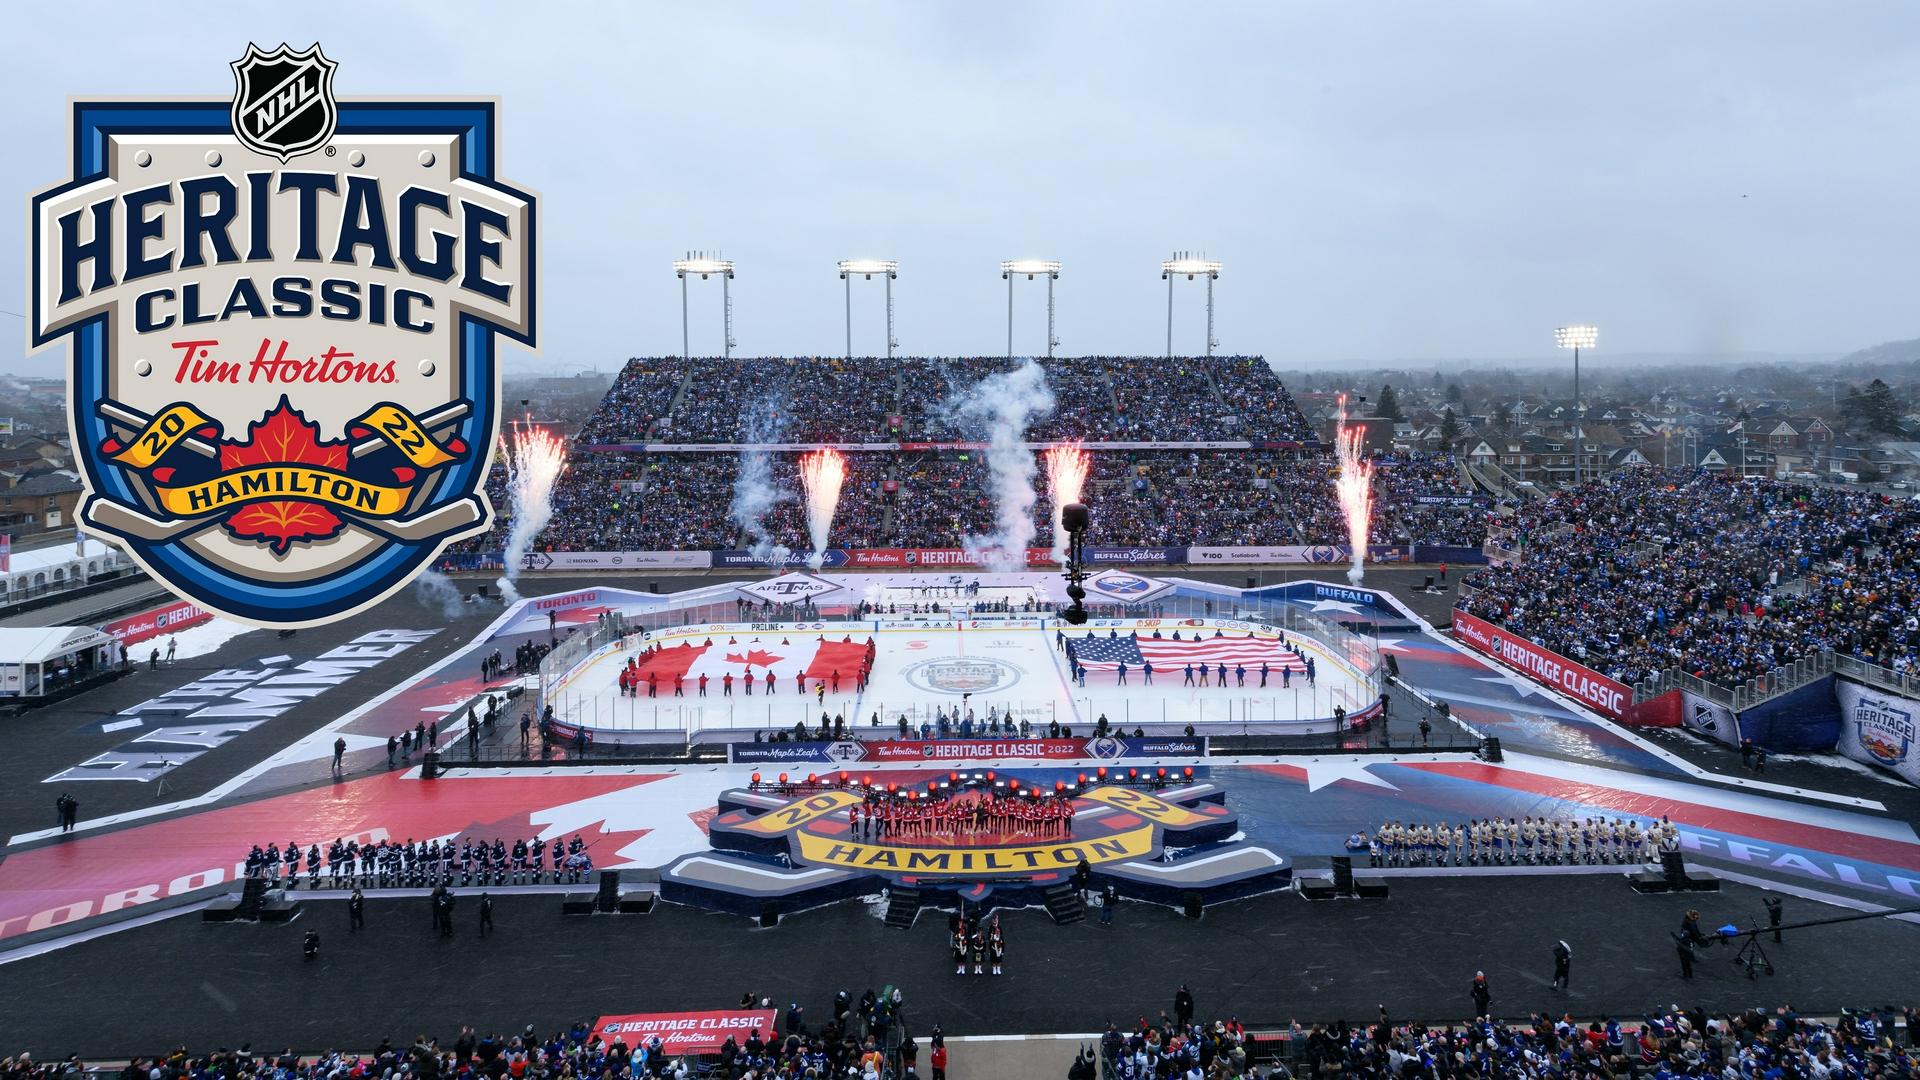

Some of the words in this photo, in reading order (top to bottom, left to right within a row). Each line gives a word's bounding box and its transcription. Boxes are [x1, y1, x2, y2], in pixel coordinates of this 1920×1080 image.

[763, 552, 801, 566] Maple
[856, 553, 869, 563] Tim
[868, 552, 899, 562] Hortons
[921, 551, 978, 564] HERITAGE
[1129, 549, 1167, 562] Sabres
[535, 592, 596, 610] TORONTO
[1317, 587, 1373, 603] BUFFALO
[112, 627, 127, 640] Tim
[126, 621, 155, 637] Hortons
[751, 623, 779, 631] PROLINE
[1144, 619, 1161, 627] SKIP
[61, 632, 99, 649] SPORTSNET
[926, 666, 1002, 675] HERITAGE
[1455, 618, 1466, 635] Tim
[1465, 622, 1490, 647] Hortons
[1503, 639, 1561, 684] HERITAGE
[1563, 669, 1624, 715] CLASSIC
[117, 668, 279, 716] THE
[41, 628, 447, 783] HAMMER
[1856, 709, 1912, 738] HERITAGE
[1863, 721, 1901, 739] CLASSIC
[768, 748, 794, 759] Maple
[795, 747, 819, 757] Leafs
[878, 746, 894, 756] Tim
[893, 746, 920, 756] Hortons
[936, 744, 993, 757] HERITAGE
[995, 743, 1045, 757] CLASSIC
[1047, 745, 1074, 754] 2022
[1168, 742, 1196, 753] Sabres
[777, 796, 838, 825] 20
[1108, 790, 1169, 819] 22
[825, 839, 1130, 871] HAMILTON
[622, 1020, 690, 1033] HERITAGE
[692, 1016, 764, 1030] CLASSIC
[666, 1032, 716, 1044] Hortons
[1125, 1065, 1134, 1077] 91
